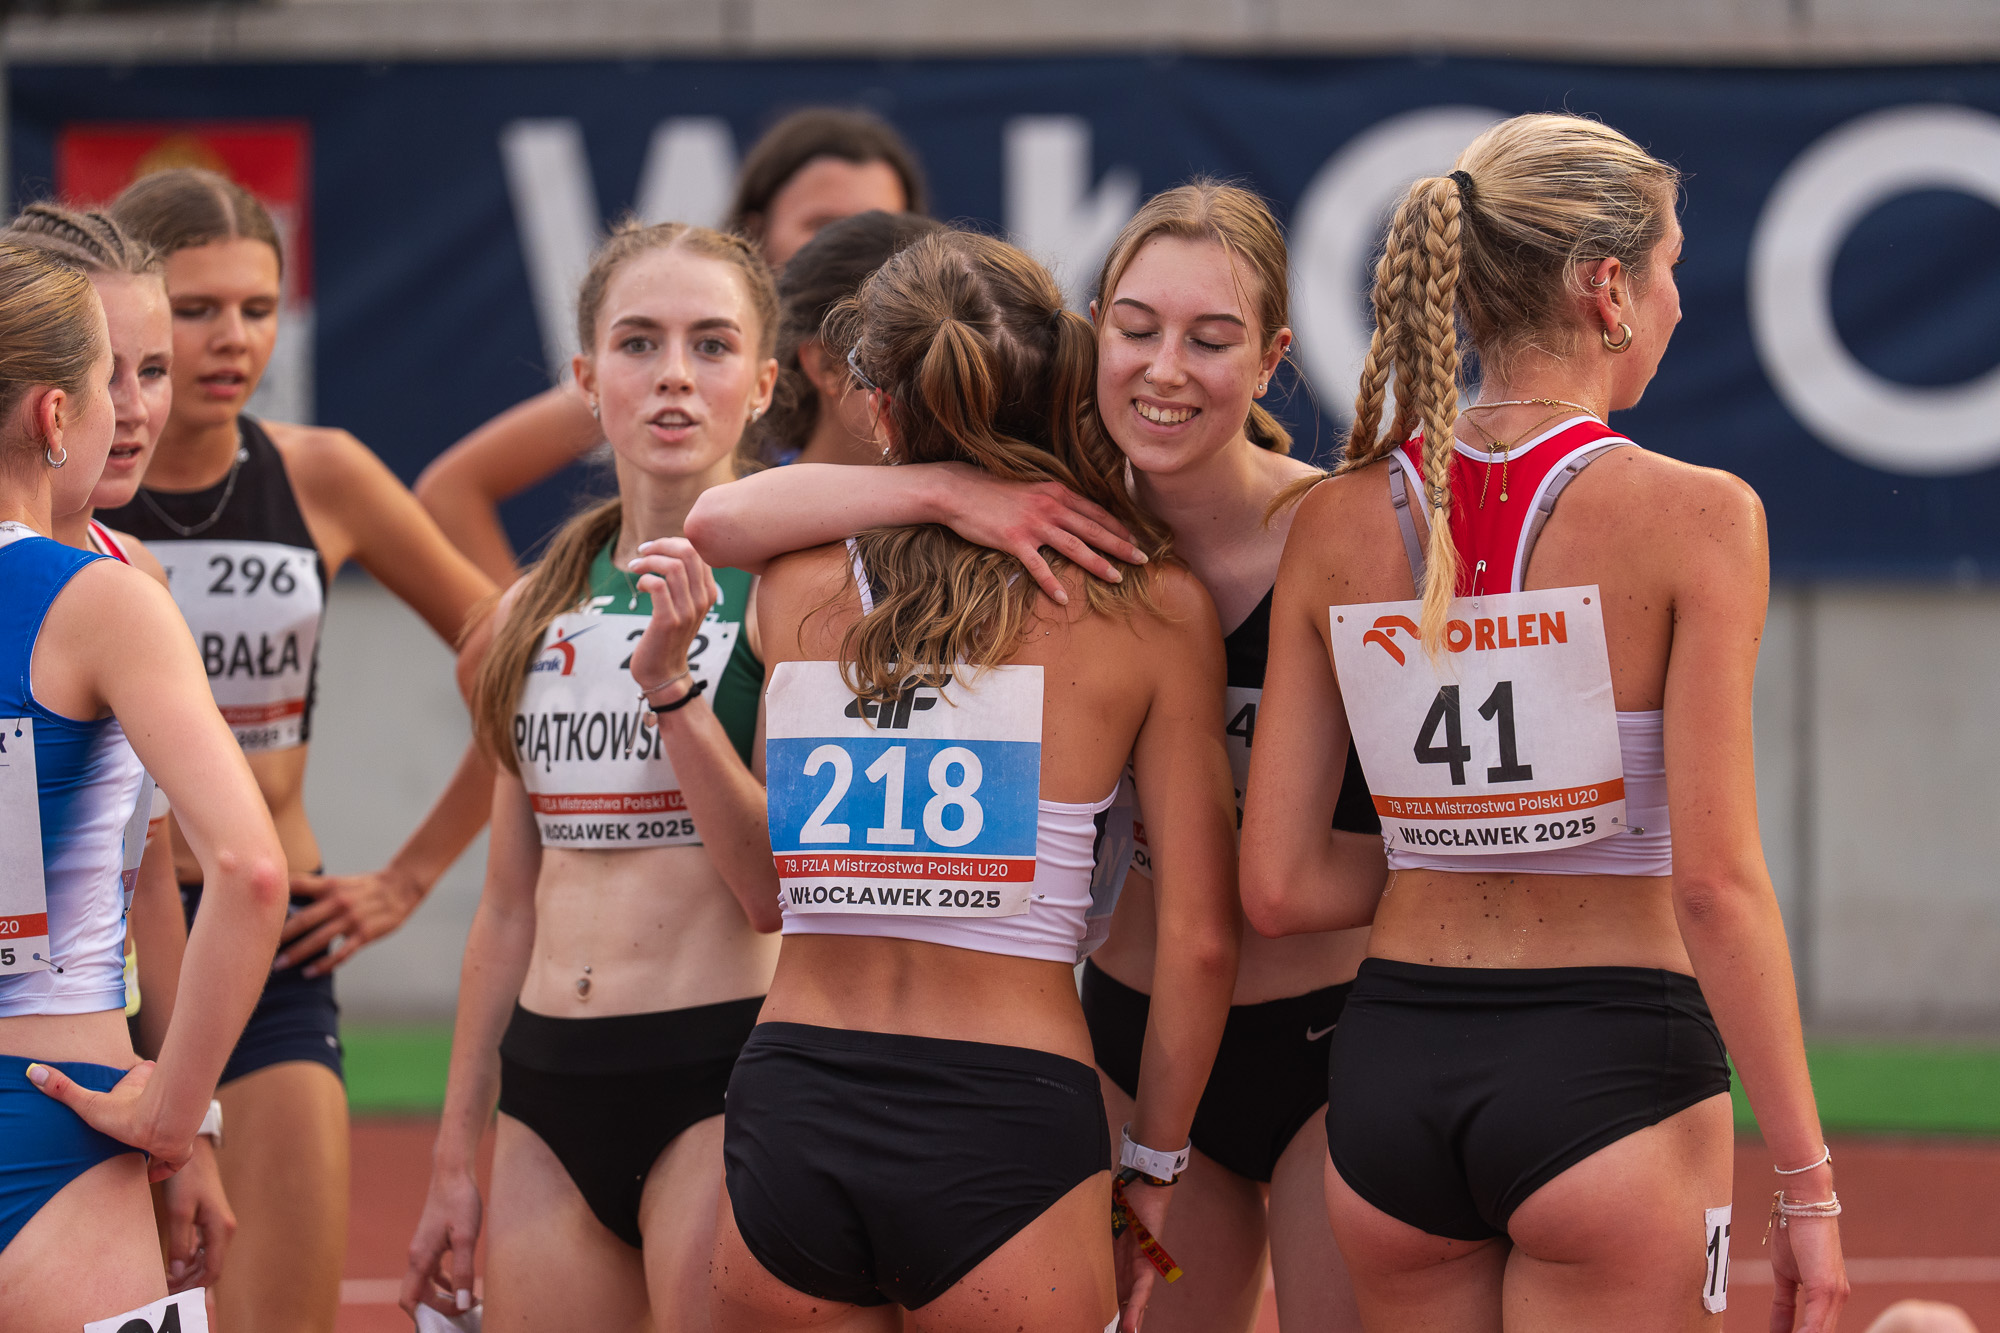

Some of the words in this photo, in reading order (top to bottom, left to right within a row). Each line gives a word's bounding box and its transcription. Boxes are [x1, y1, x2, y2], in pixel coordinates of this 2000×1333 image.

[208, 556, 296, 595] 296
[1445, 611, 1568, 653] ORLEN
[620, 629, 709, 671] 22
[1413, 681, 1533, 786] 41
[623, 794, 665, 810] Polski
[799, 744, 984, 847] 218
[1388, 800, 1405, 813] 79.
[1406, 802, 1433, 815] PZLA
[1436, 799, 1515, 816] Mistrzostwa
[1519, 793, 1564, 811] Polski
[1567, 788, 1599, 806] U20
[637, 818, 696, 840] 2025
[1399, 826, 1529, 847] WŁOCŁAWEK
[1534, 816, 1596, 843] 2025
[785, 859, 799, 873] 79.
[802, 859, 830, 873] PZLA
[833, 858, 923, 875] Mistrzostwa
[928, 861, 973, 876] Polski
[978, 863, 1008, 878] U20
[789, 886, 932, 908] WŁOCŁAWEK
[938, 888, 1000, 909] 2025
